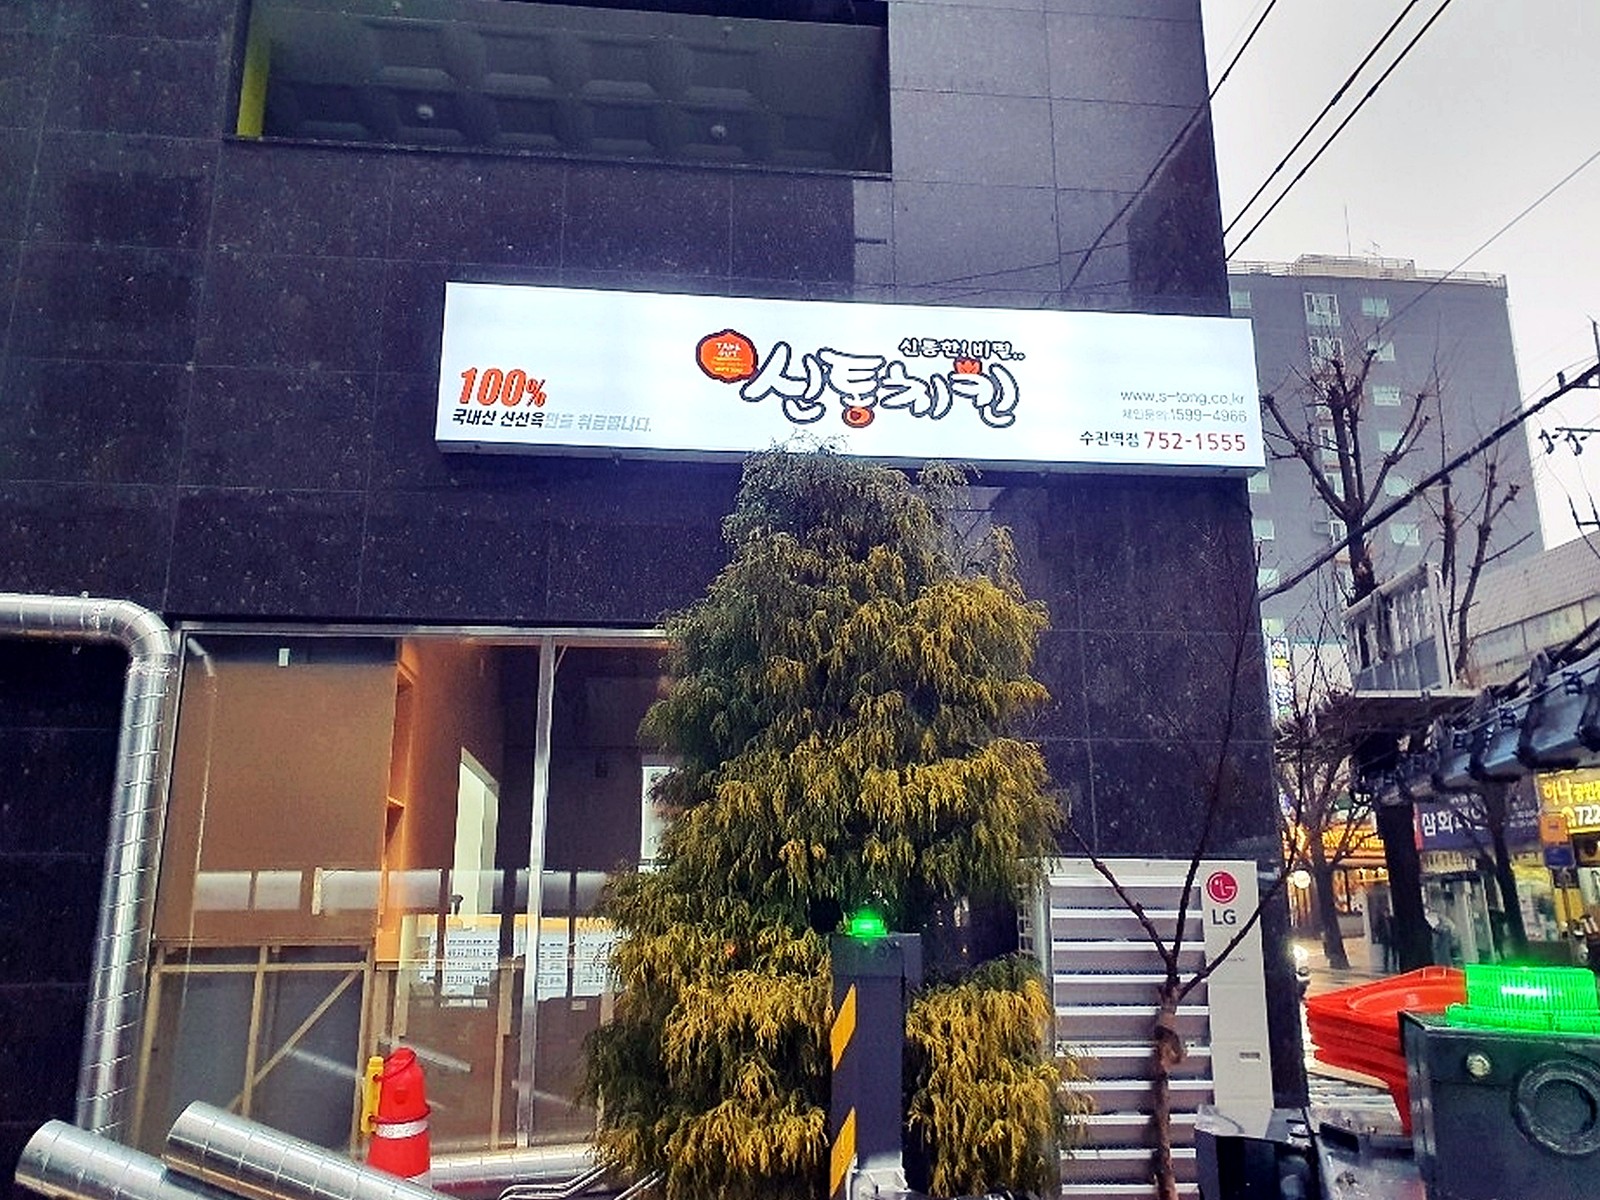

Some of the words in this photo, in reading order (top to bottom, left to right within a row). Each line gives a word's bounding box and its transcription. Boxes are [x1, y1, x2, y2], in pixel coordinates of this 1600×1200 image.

[459, 367, 547, 408] 100%
[1120, 391, 1244, 406] www.s-tong.co.kr
[452, 408, 497, 426] 국내산
[1143, 430, 1246, 452] 752-1555
[1212, 909, 1236, 925] LG
